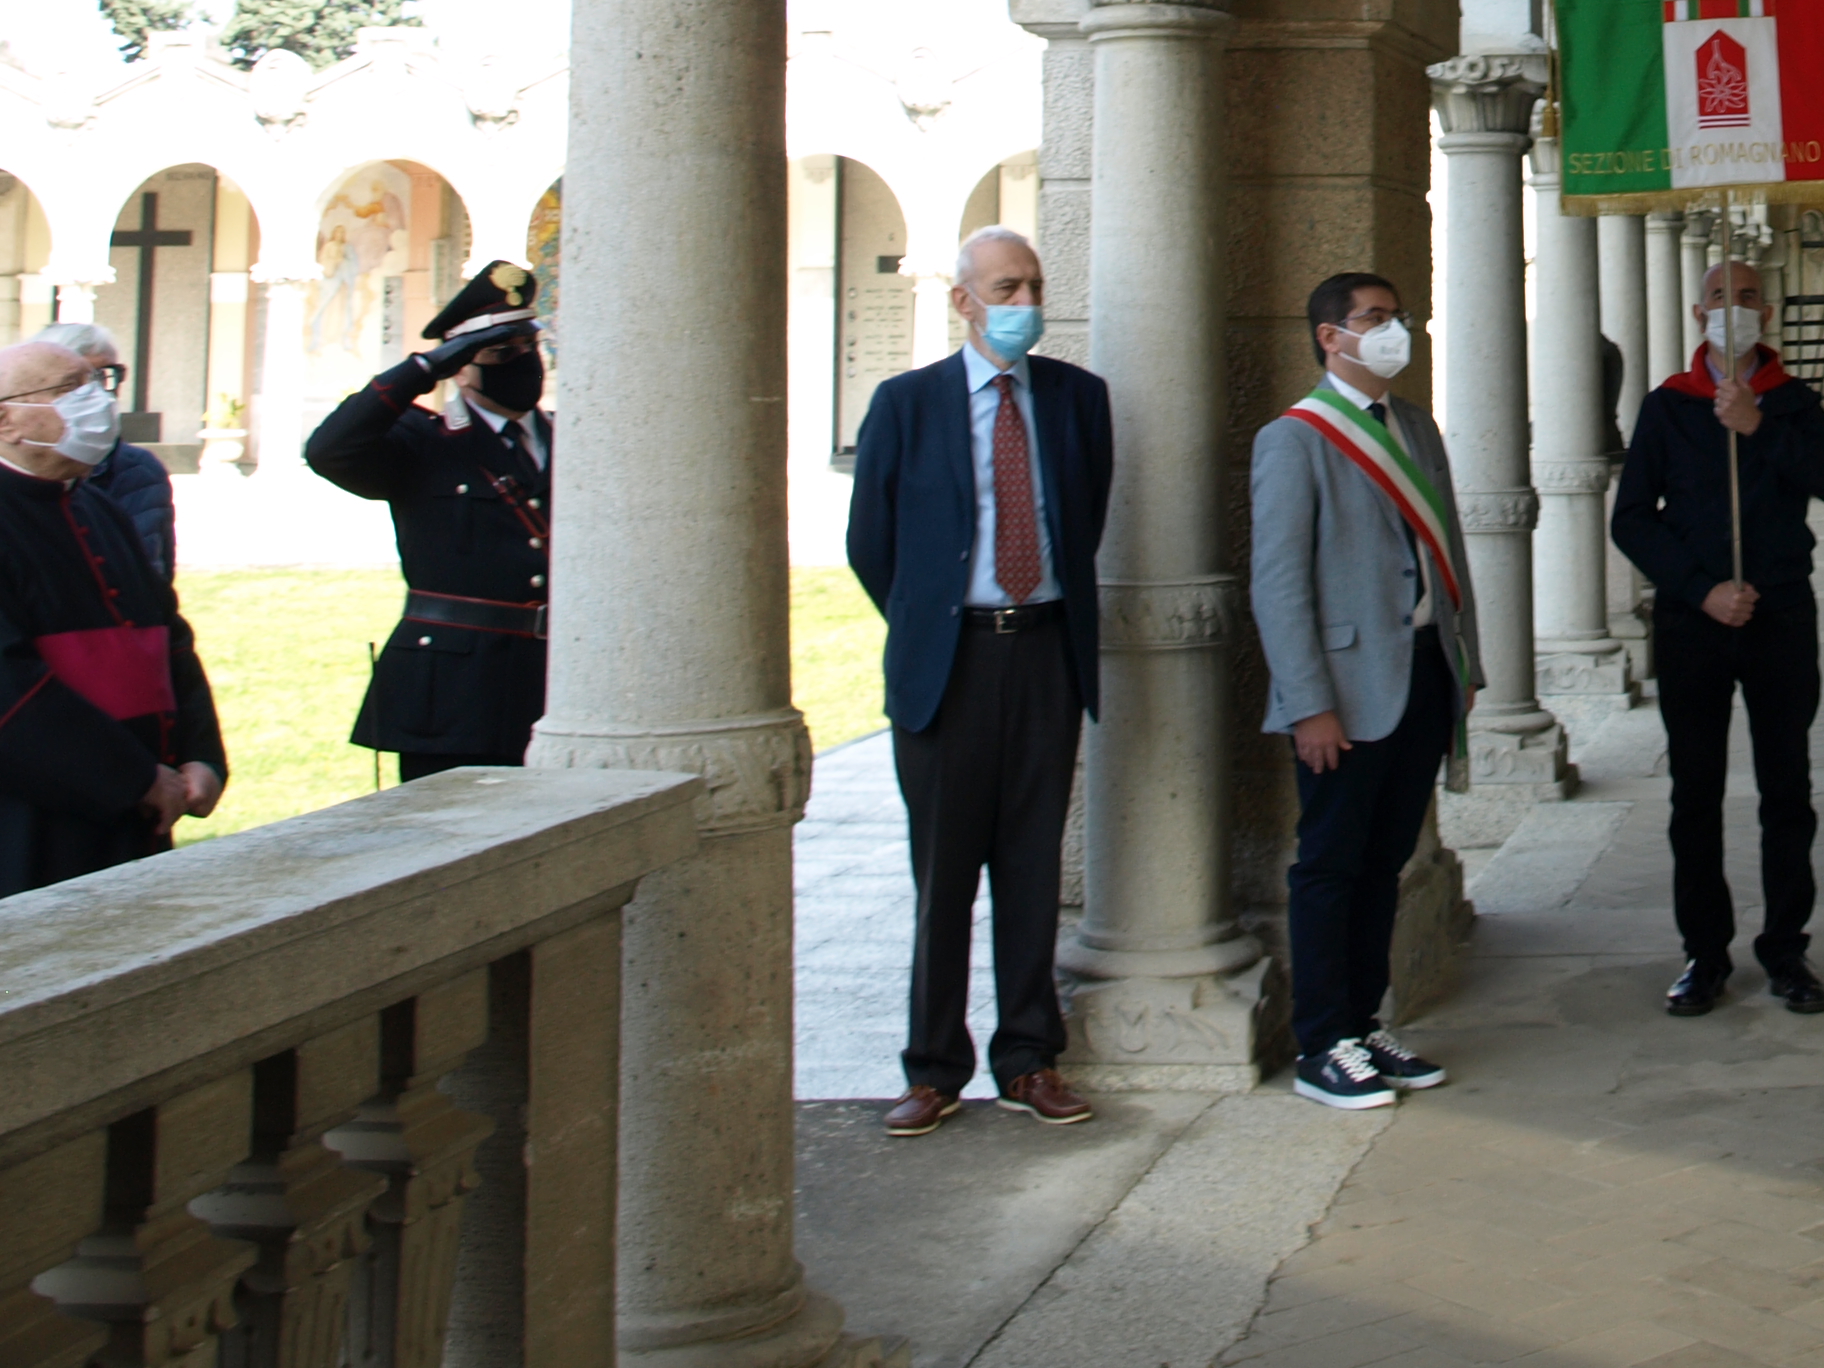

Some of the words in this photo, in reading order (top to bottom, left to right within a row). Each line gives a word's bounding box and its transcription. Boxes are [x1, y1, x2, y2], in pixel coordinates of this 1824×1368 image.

[1568, 149, 1656, 175] SEZIONE
[1660, 147, 1684, 171] DI
[1690, 140, 1821, 166] ROMAGNANO
